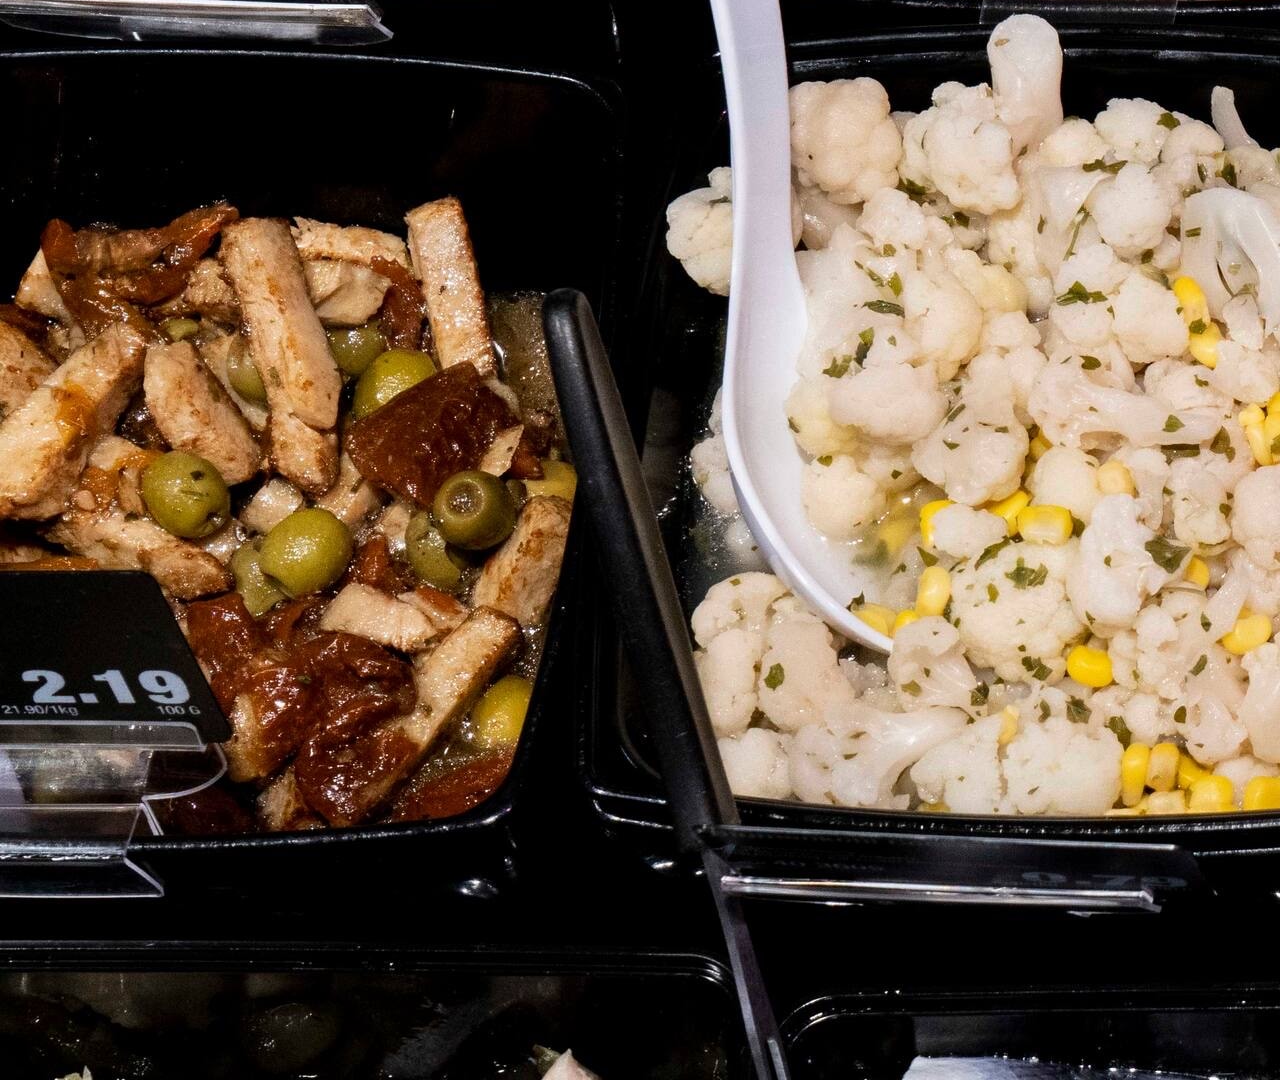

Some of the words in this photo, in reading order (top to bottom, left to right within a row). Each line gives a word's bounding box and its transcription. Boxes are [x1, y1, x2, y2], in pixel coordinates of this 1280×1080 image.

[21, 669, 191, 705] 2.19
[1, 704, 79, 717] 21.90/1kg
[157, 705, 185, 715] 100
[188, 705, 202, 716] G
